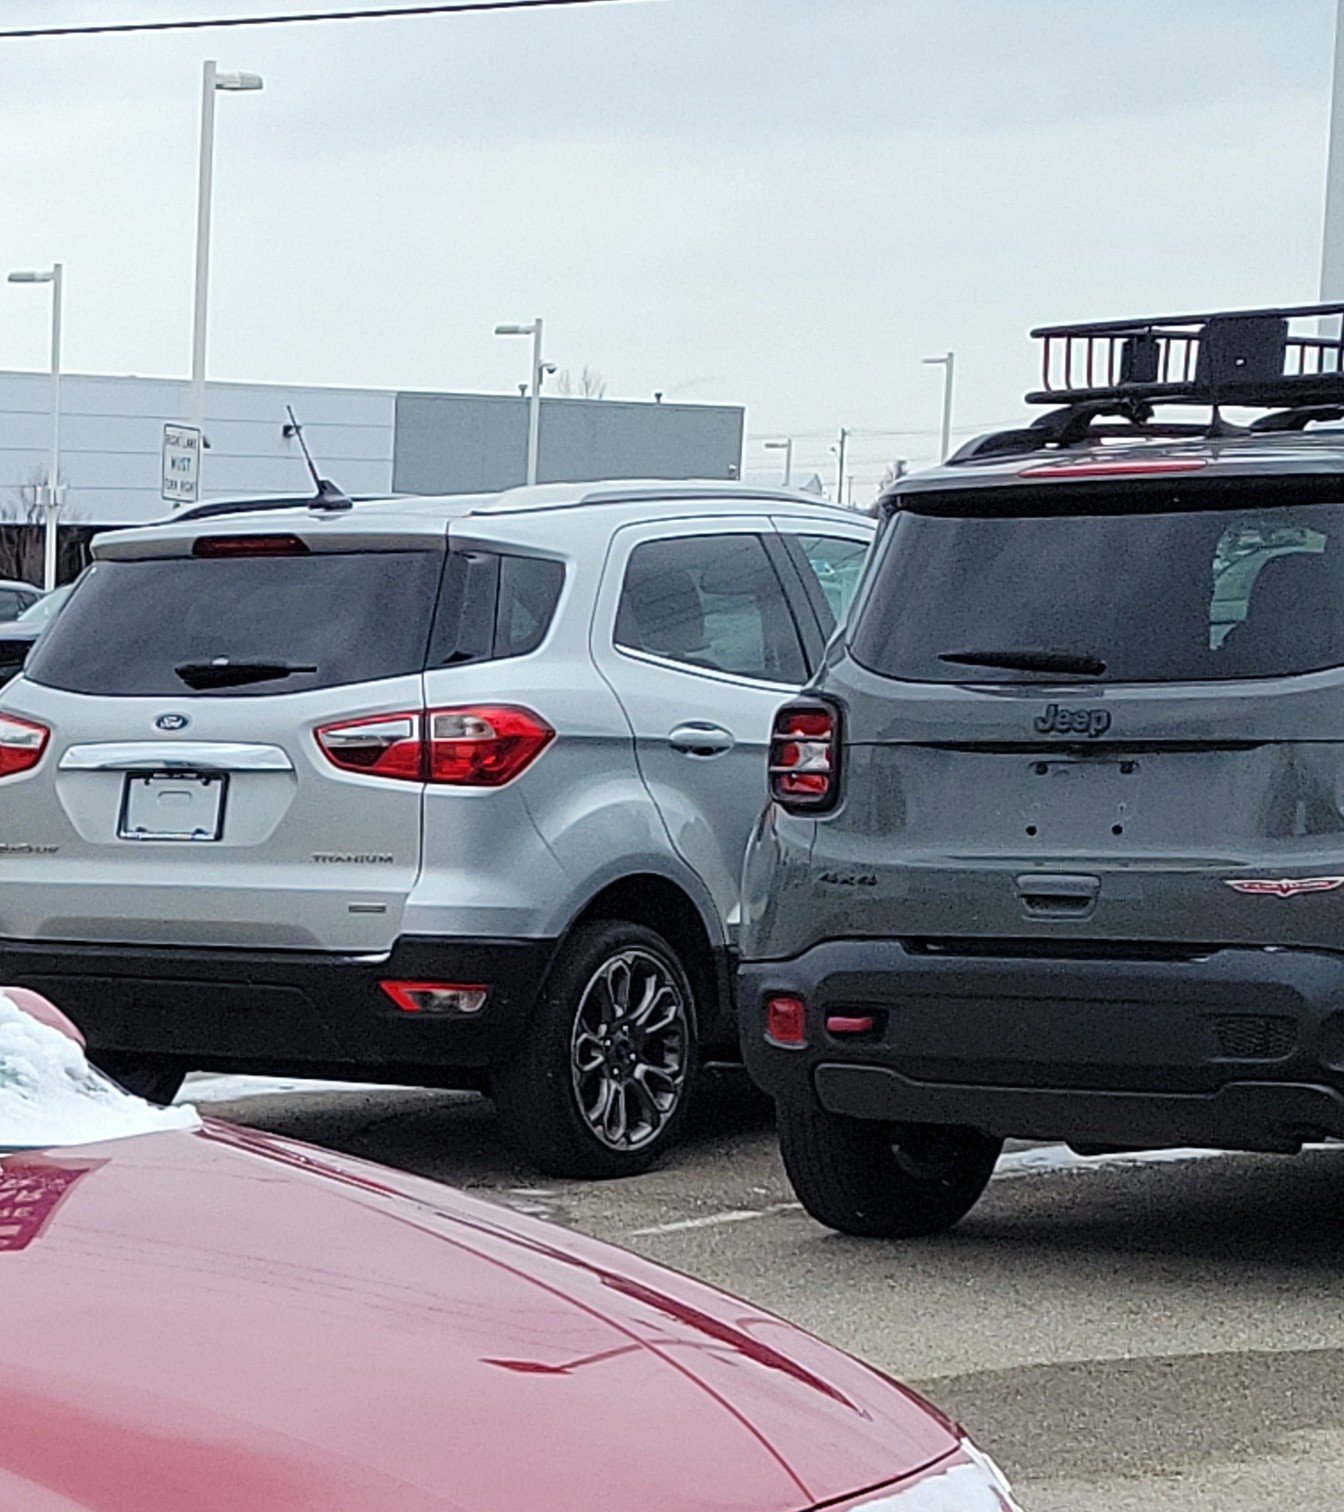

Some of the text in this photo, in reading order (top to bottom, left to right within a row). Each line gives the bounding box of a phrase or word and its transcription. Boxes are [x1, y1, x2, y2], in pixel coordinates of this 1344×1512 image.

[158, 715, 185, 729] Ford
[1033, 704, 1111, 738] Jeep
[312, 853, 394, 864] TITANIUM
